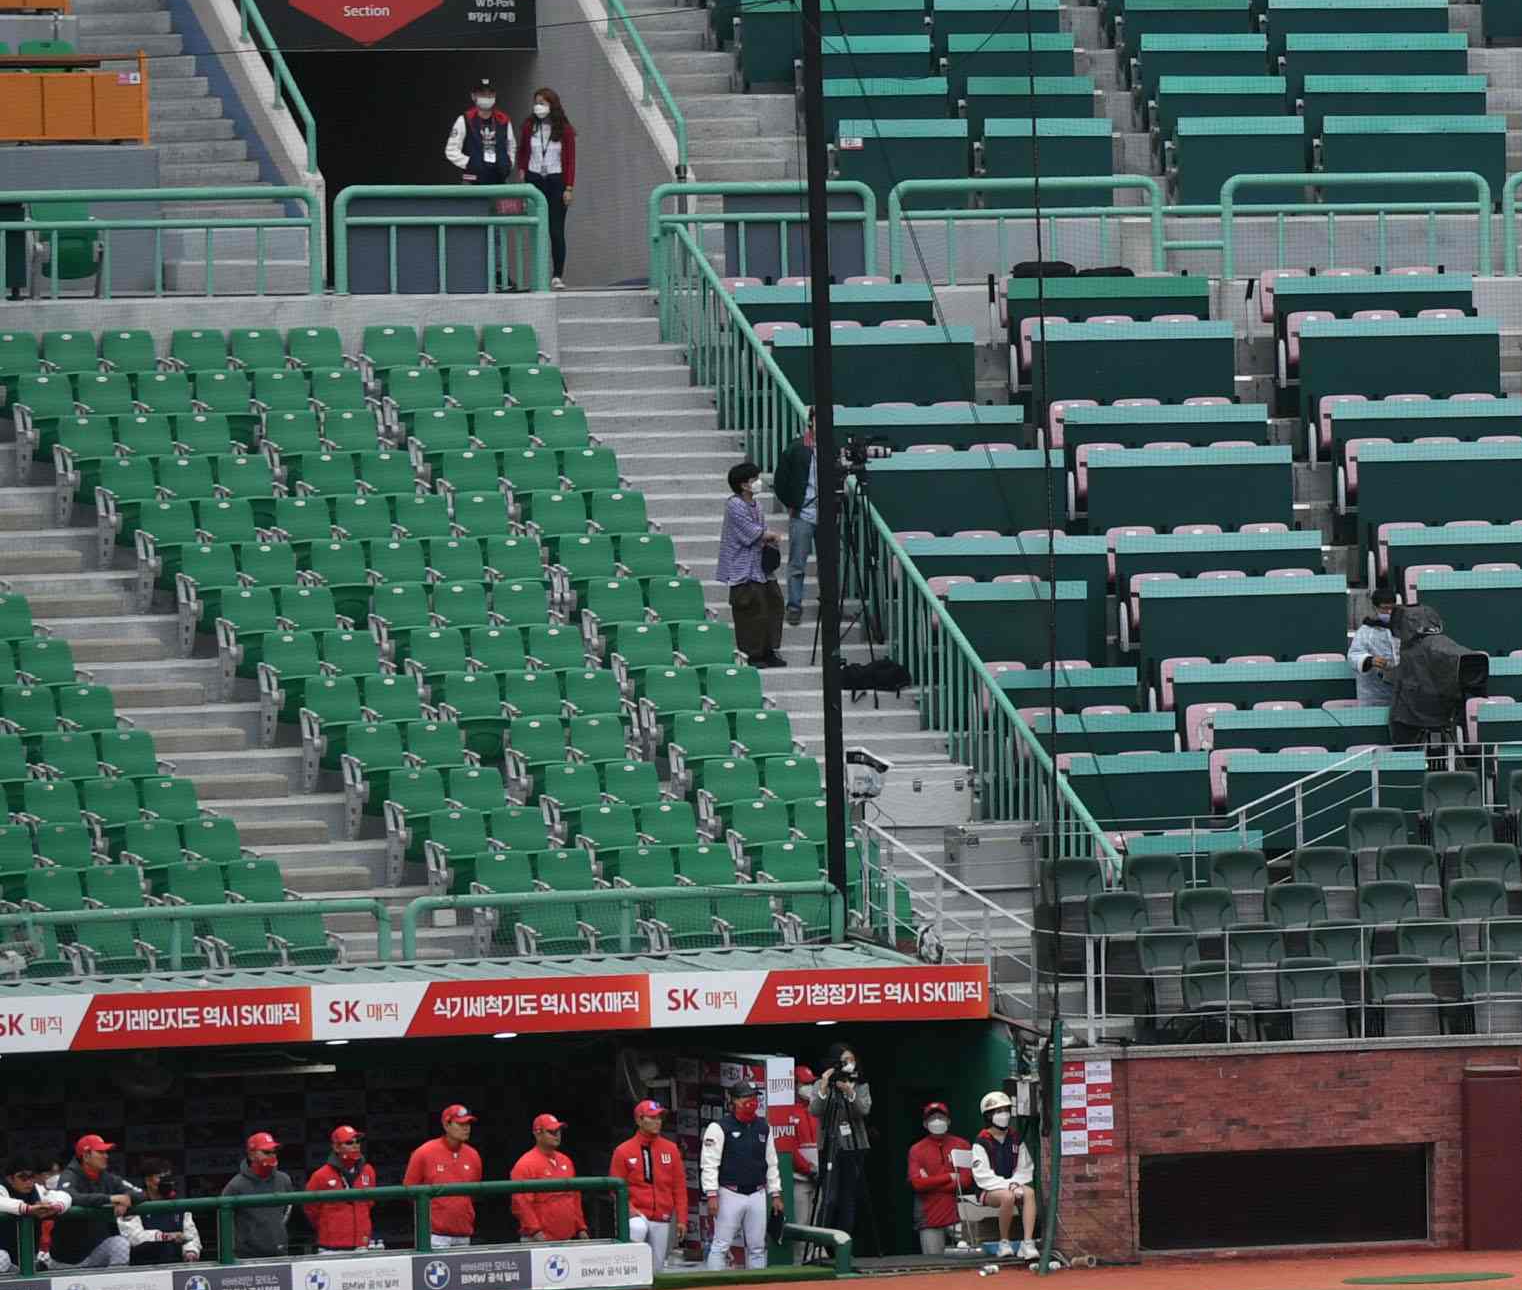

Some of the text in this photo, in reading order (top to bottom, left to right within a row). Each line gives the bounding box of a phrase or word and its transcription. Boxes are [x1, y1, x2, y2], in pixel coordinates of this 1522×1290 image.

[343, 4, 391, 21] Section
[433, 989, 640, 1020] 식기세척기도 역시 SK매직
[667, 988, 738, 1011] SK 매직
[775, 981, 983, 1007] 공기청정기도 역시 SK매직
[95, 1003, 301, 1033] 전기레인지도 역시 SK매직
[328, 1000, 399, 1024] SK 매직
[31, 1014, 63, 1035] 매직
